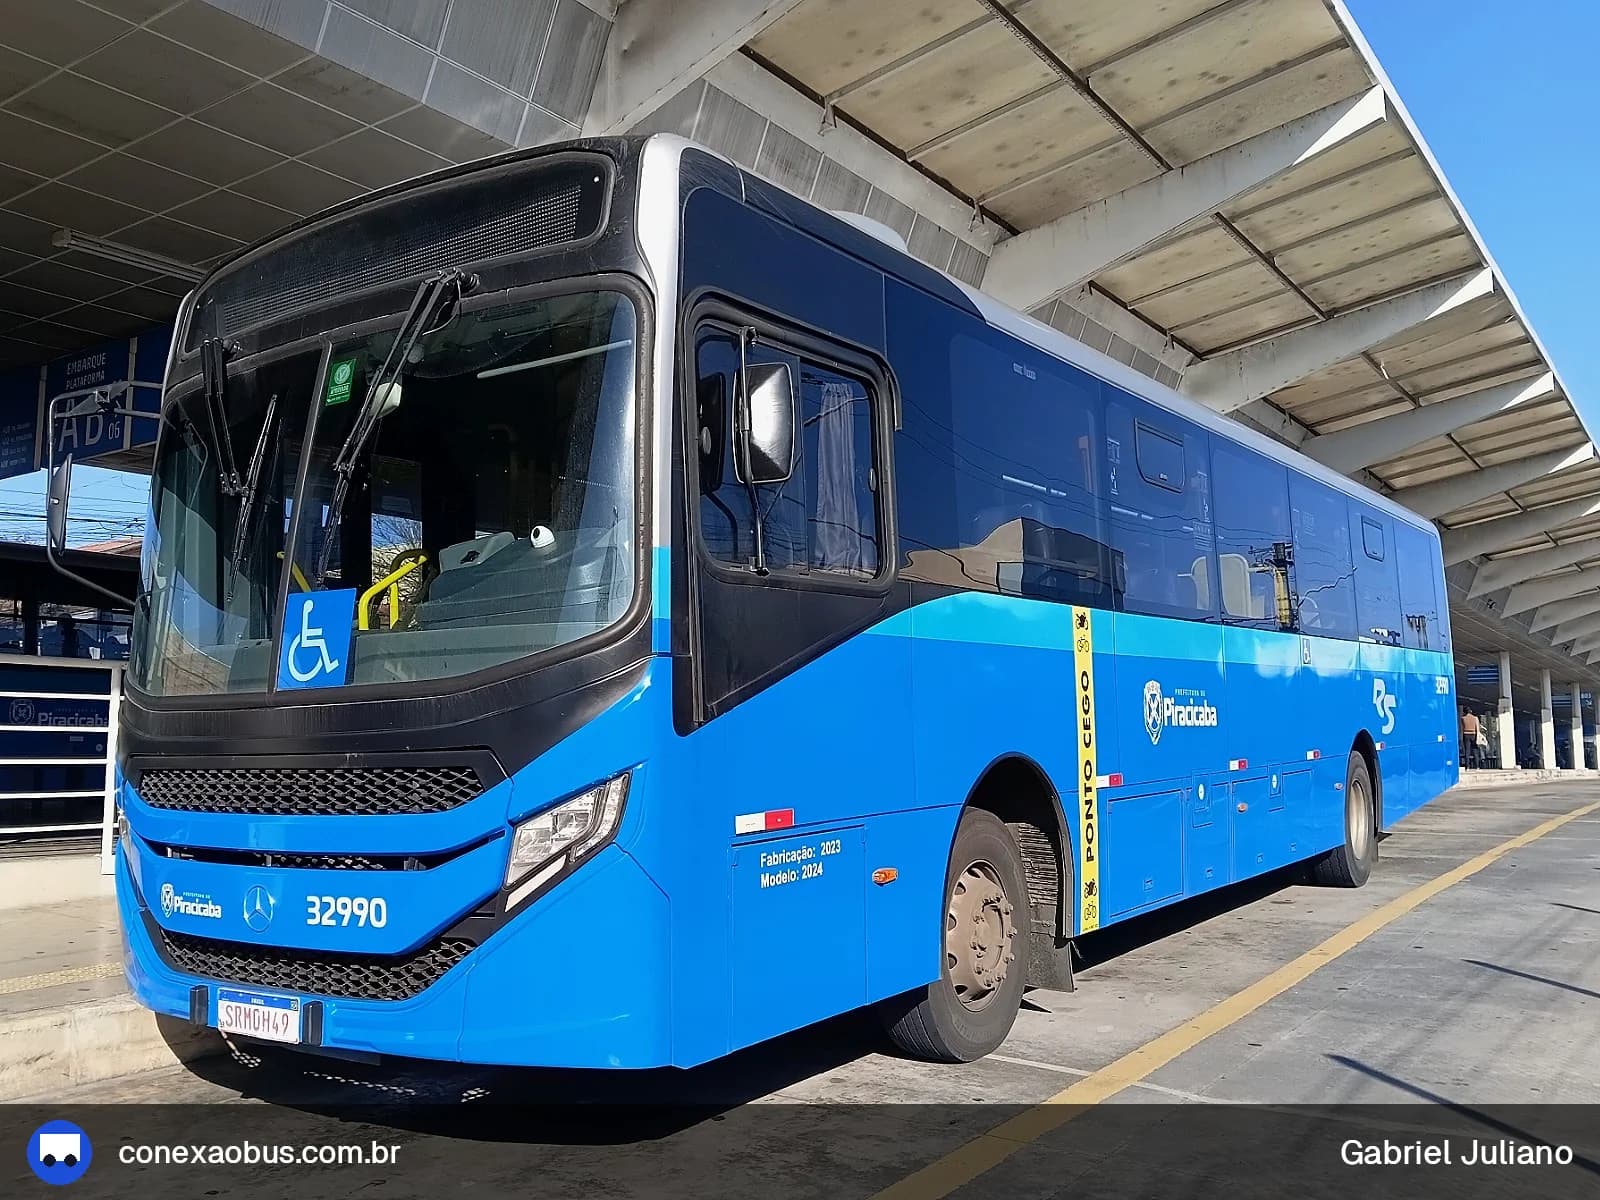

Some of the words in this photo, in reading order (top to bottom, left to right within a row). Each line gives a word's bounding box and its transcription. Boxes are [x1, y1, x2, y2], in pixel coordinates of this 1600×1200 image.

[67, 352, 107, 374] EMBARQUE
[66, 370, 105, 390] PLATAFORMA
[1080, 670, 1092, 749] CEGO
[1163, 697, 1218, 727] Piracicaba
[1083, 759, 1095, 862] PONTO
[760, 845, 816, 868] Fabricação:
[820, 839, 842, 856] 2023
[760, 868, 800, 889] Modelo:
[801, 861, 824, 880] 2024
[174, 896, 222, 919] Piracicaba
[306, 895, 388, 929] 32990
